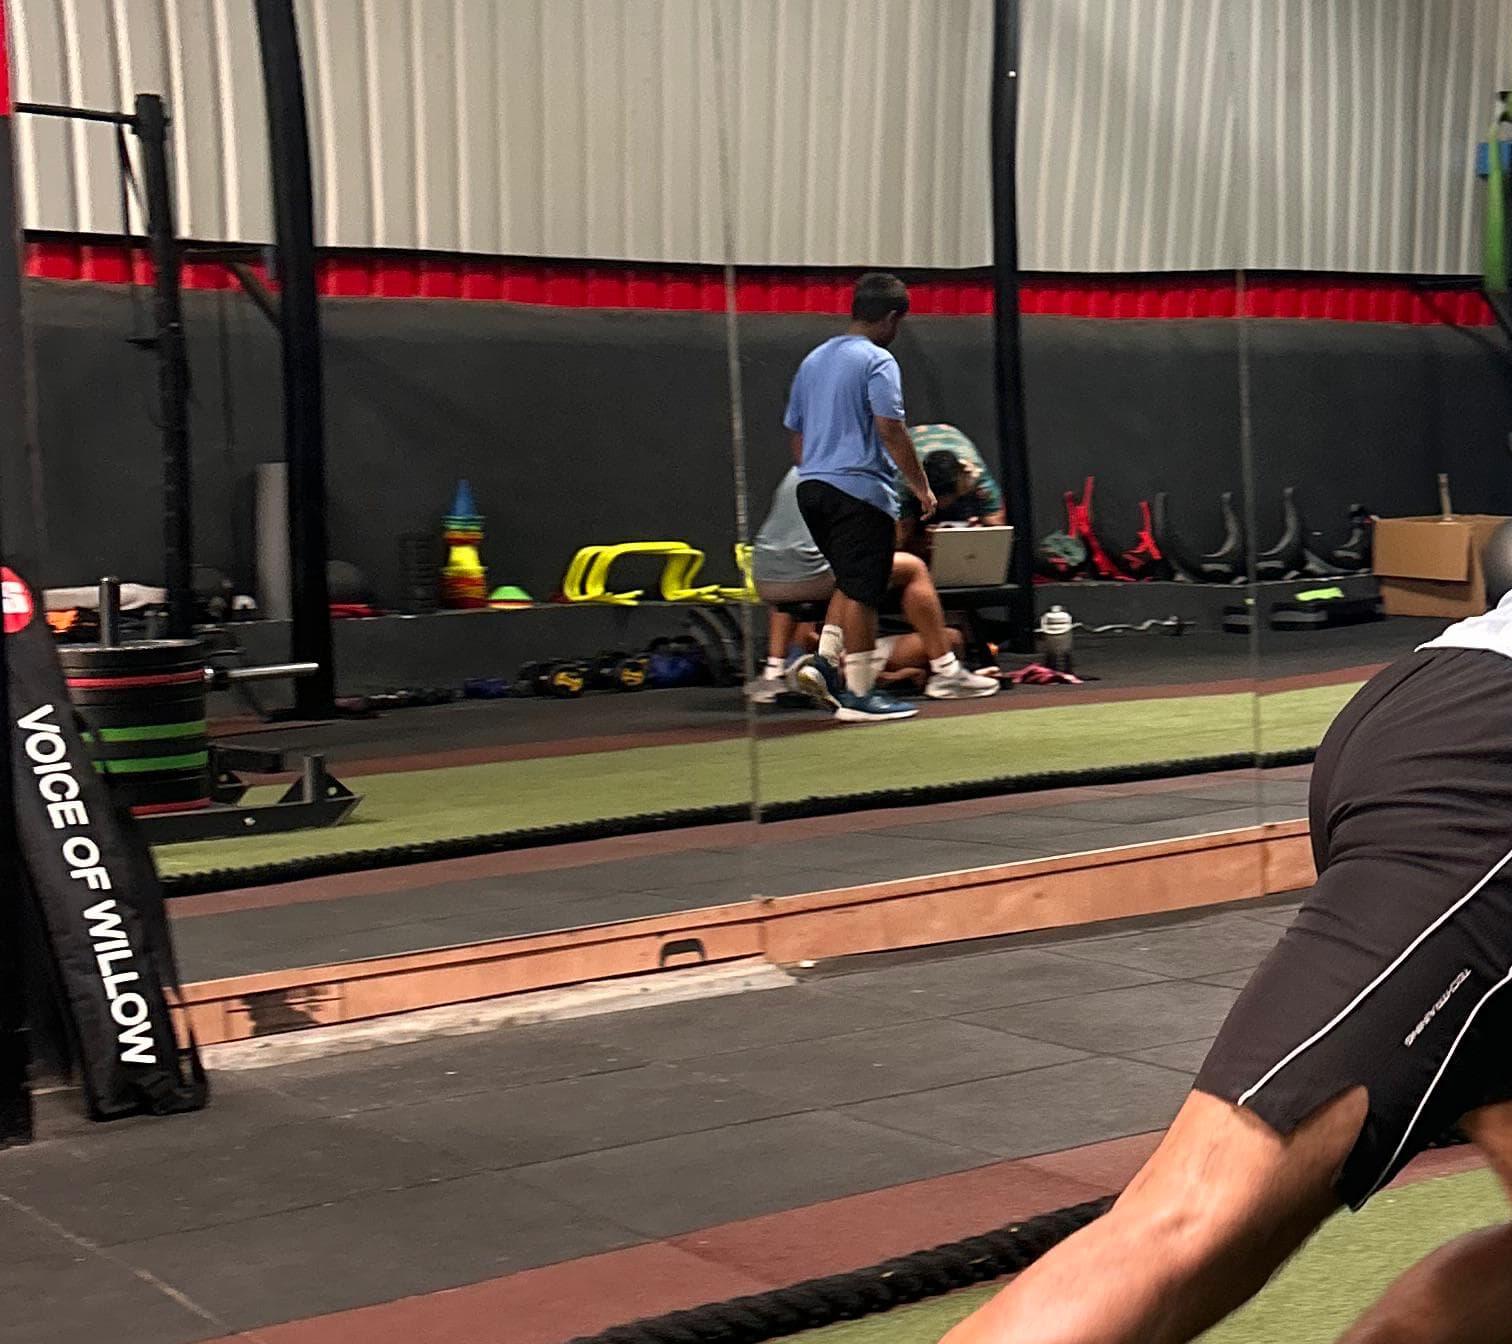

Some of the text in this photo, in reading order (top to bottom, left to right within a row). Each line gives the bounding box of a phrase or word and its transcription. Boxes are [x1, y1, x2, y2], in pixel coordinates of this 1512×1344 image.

[17, 705, 157, 1064] VOICE OF WILLOW
